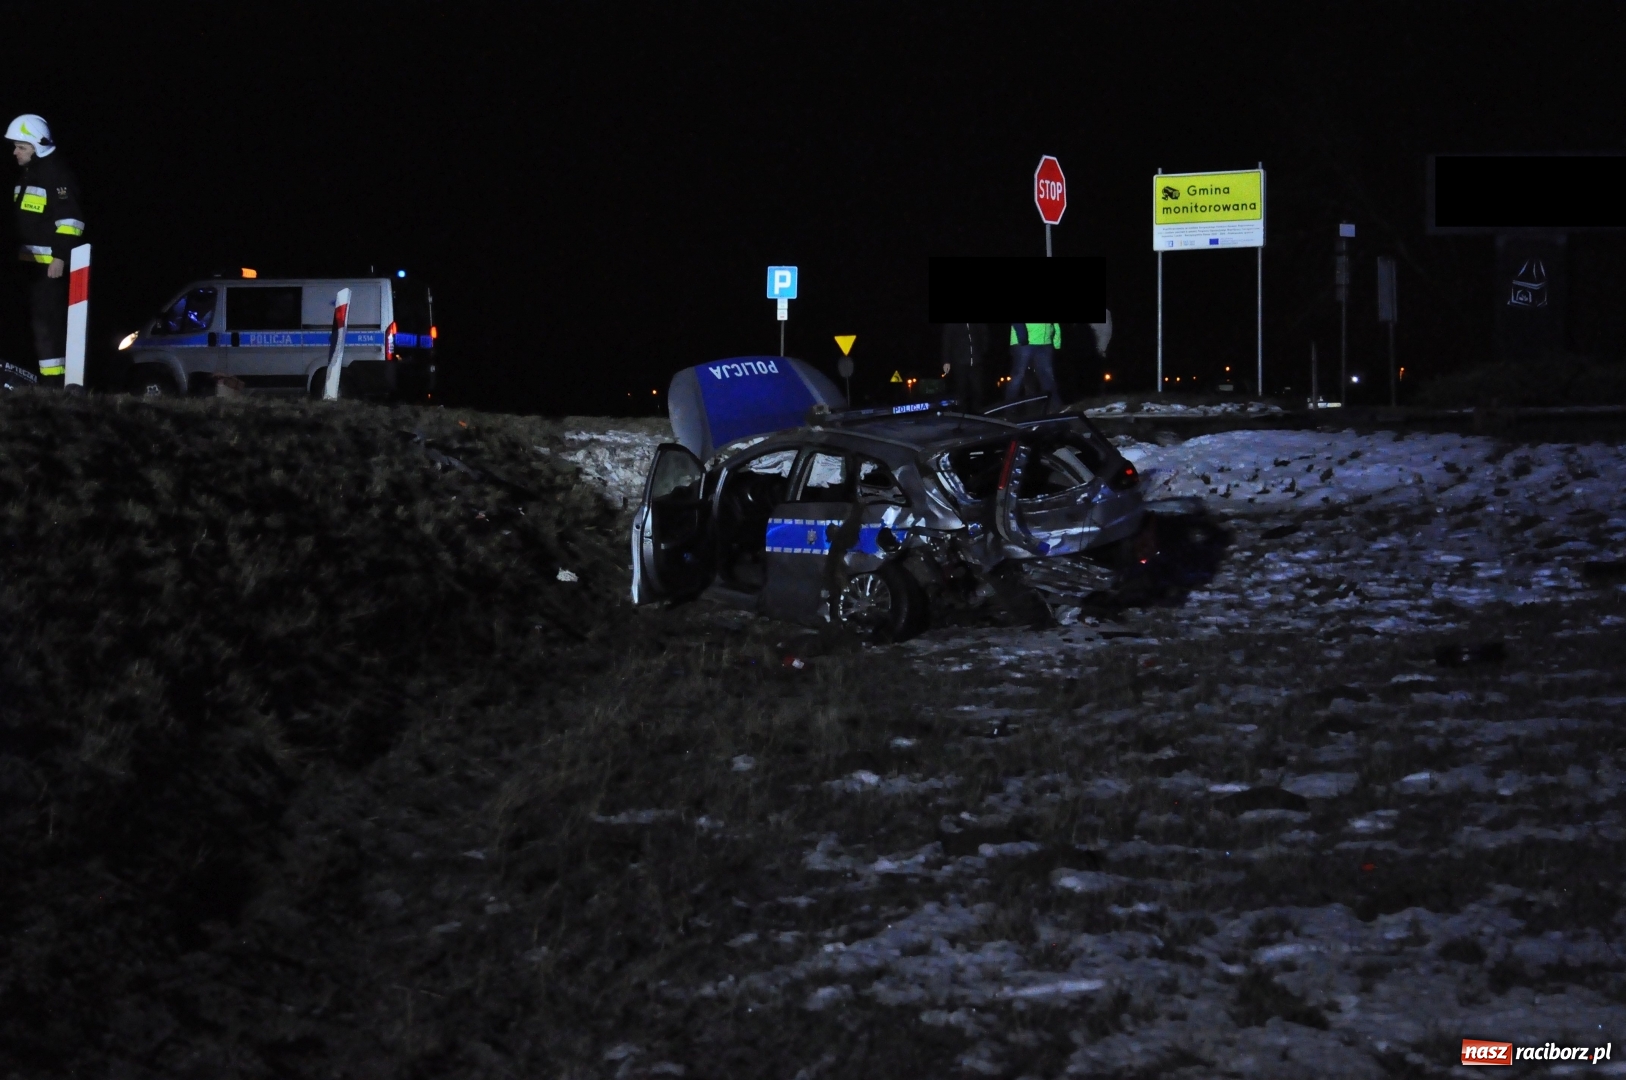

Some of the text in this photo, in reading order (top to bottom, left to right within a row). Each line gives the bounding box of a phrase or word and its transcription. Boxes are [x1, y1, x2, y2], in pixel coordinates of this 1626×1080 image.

[1039, 179, 1062, 201] STOP
[1187, 184, 1230, 196] Gmina
[1162, 202, 1256, 214] monitorowana
[774, 270, 791, 295] P
[250, 334, 292, 344] POLICJA
[709, 360, 779, 380] POLICJA
[894, 403, 928, 414] POLICJA
